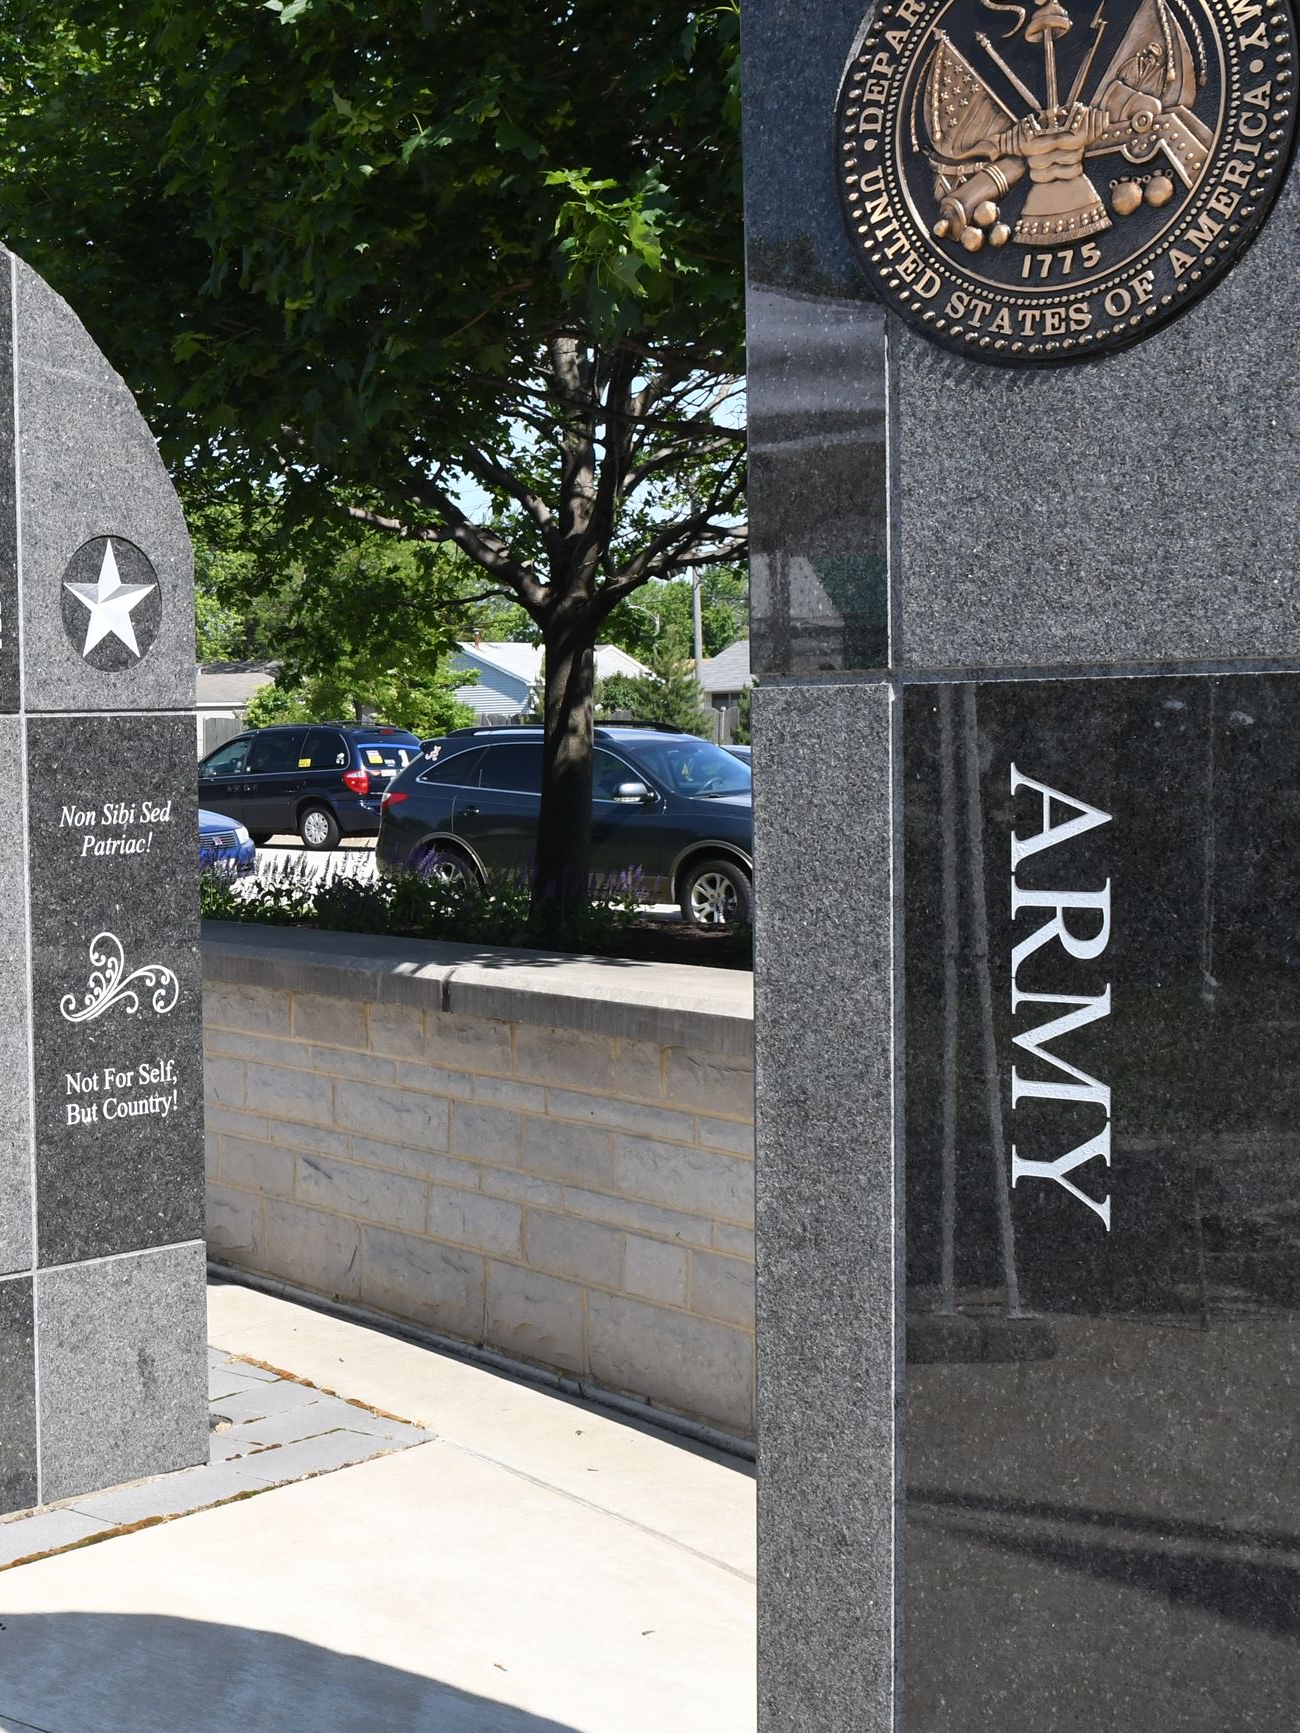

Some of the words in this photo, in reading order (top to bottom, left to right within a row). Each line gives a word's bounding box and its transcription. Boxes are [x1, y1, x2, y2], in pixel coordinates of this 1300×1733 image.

[1226, 0, 1271, 51] MY
[858, 0, 926, 133] DEPAR
[860, 166, 941, 300] UNITED
[944, 290, 1093, 337] STATES
[1104, 270, 1155, 318] OF
[1168, 81, 1272, 278] AMERICA
[1021, 242, 1102, 279] 1775
[59, 806, 96, 828] Non
[101, 803, 134, 826] Sibi
[139, 801, 171, 822] Sed
[1010, 762, 1113, 1232] ARMY
[65, 1072, 100, 1095] Not
[104, 1067, 134, 1091] For
[139, 1060, 178, 1084] Self,
[66, 1102, 98, 1125] But
[102, 1091, 178, 1120] Country!
